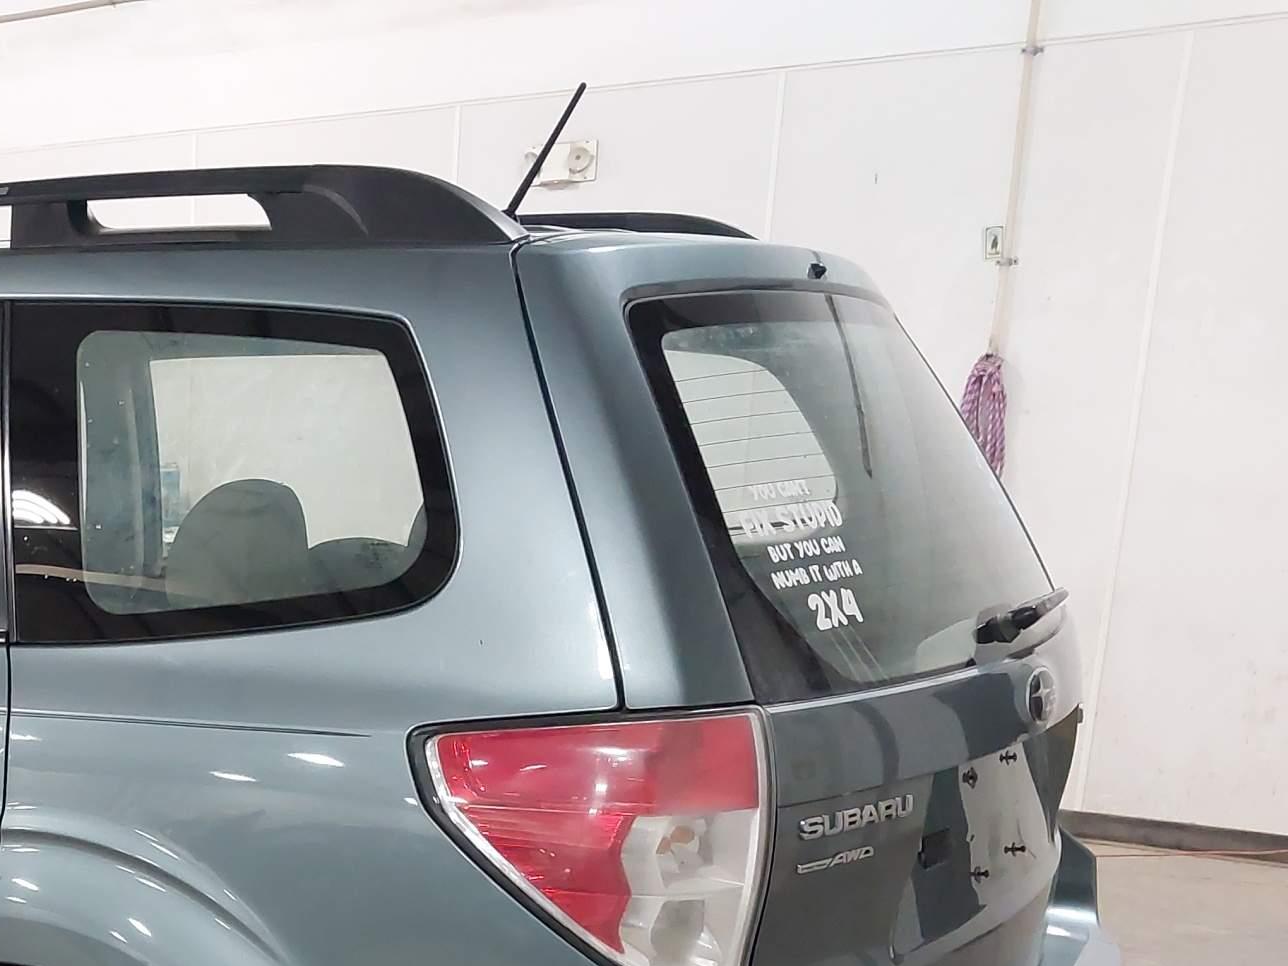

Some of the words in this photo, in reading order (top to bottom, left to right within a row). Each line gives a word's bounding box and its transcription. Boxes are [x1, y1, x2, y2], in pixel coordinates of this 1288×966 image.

[776, 502, 843, 532] STUPID
[767, 543, 794, 563] BUT
[794, 539, 821, 558] YOU
[820, 535, 846, 554] CAN
[771, 567, 810, 590] NUMB
[808, 564, 823, 582] IT
[822, 560, 854, 582] WITH
[852, 559, 863, 576] A
[807, 587, 864, 631] 2X4
[799, 794, 914, 841] SUBARU
